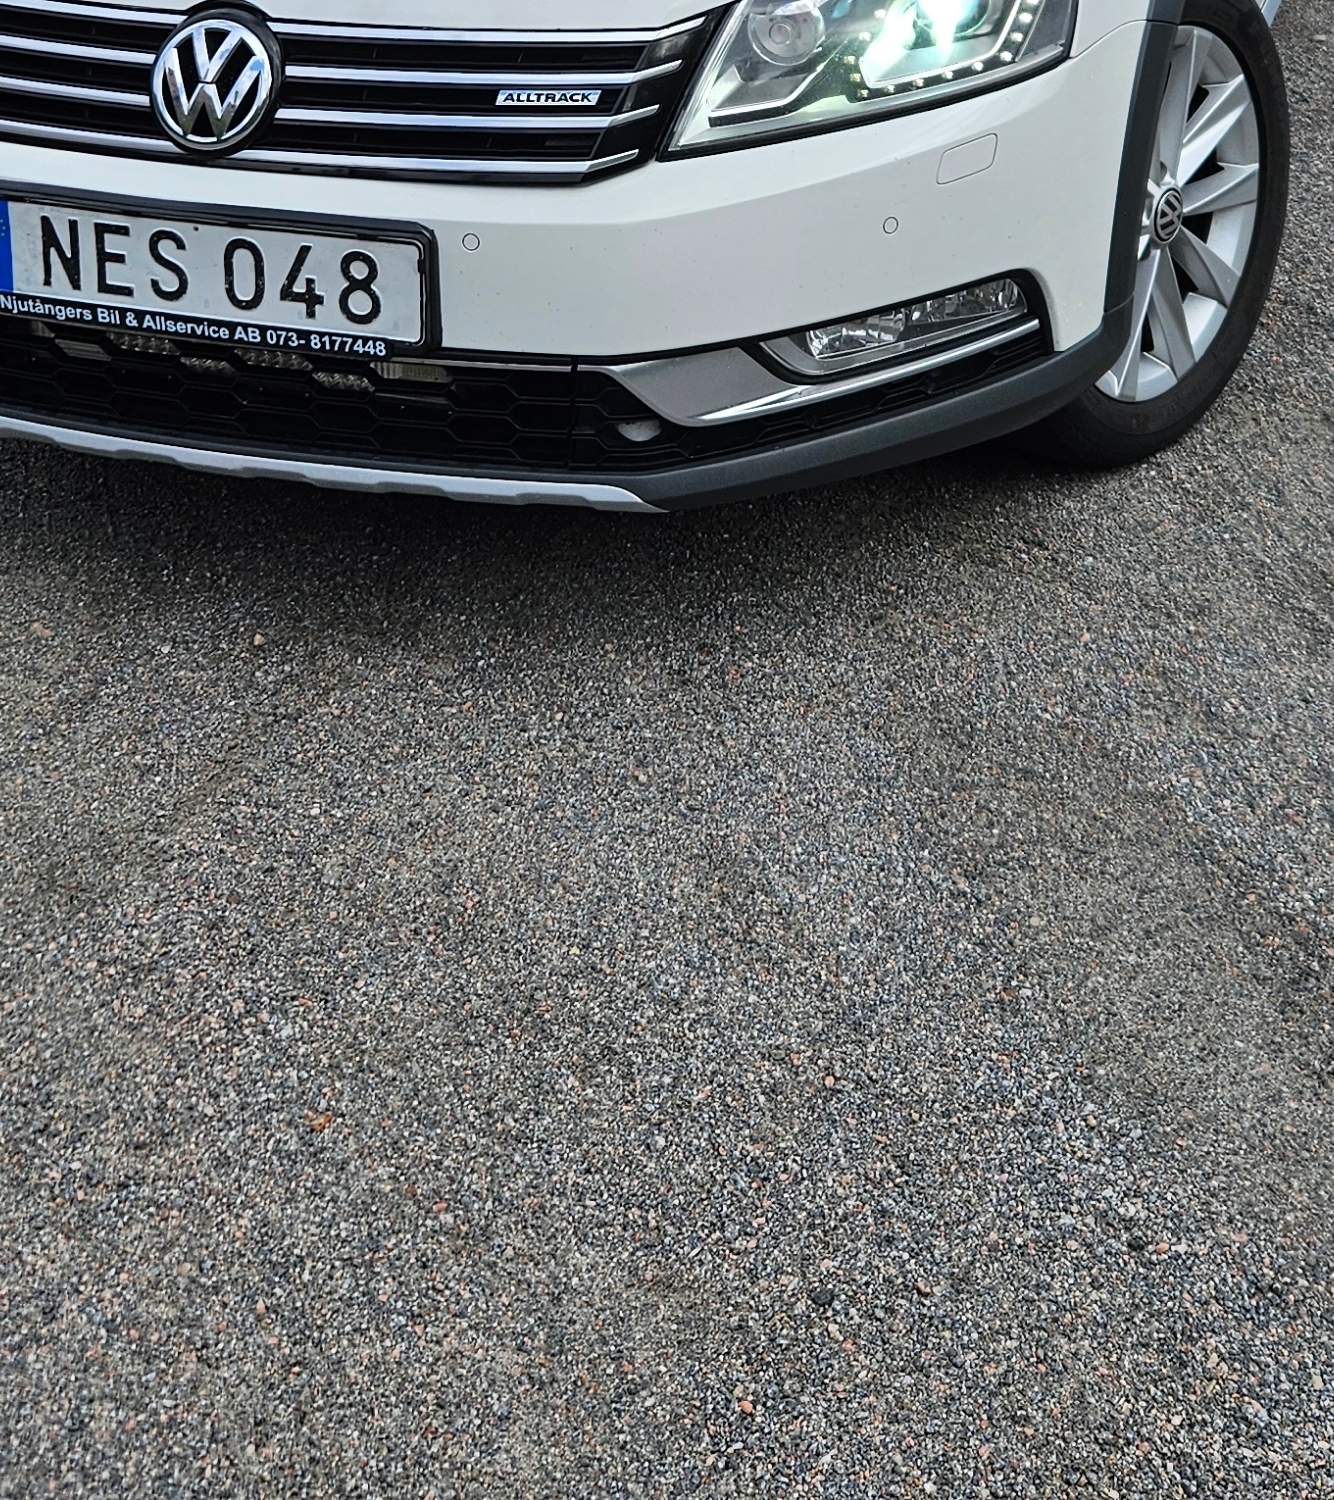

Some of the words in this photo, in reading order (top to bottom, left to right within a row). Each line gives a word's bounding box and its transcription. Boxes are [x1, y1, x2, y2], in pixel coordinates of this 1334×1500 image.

[163, 24, 267, 143] VW
[502, 92, 593, 103] ALLTRACK
[40, 214, 190, 301] NES
[223, 236, 383, 326] 048
[0, 294, 93, 321] Njutångers
[97, 308, 121, 325] Bil
[125, 311, 139, 327] &
[142, 314, 230, 339] Allservice
[234, 325, 262, 342] AB
[266, 329, 306, 347] 073-
[310, 334, 387, 357] 8177448
